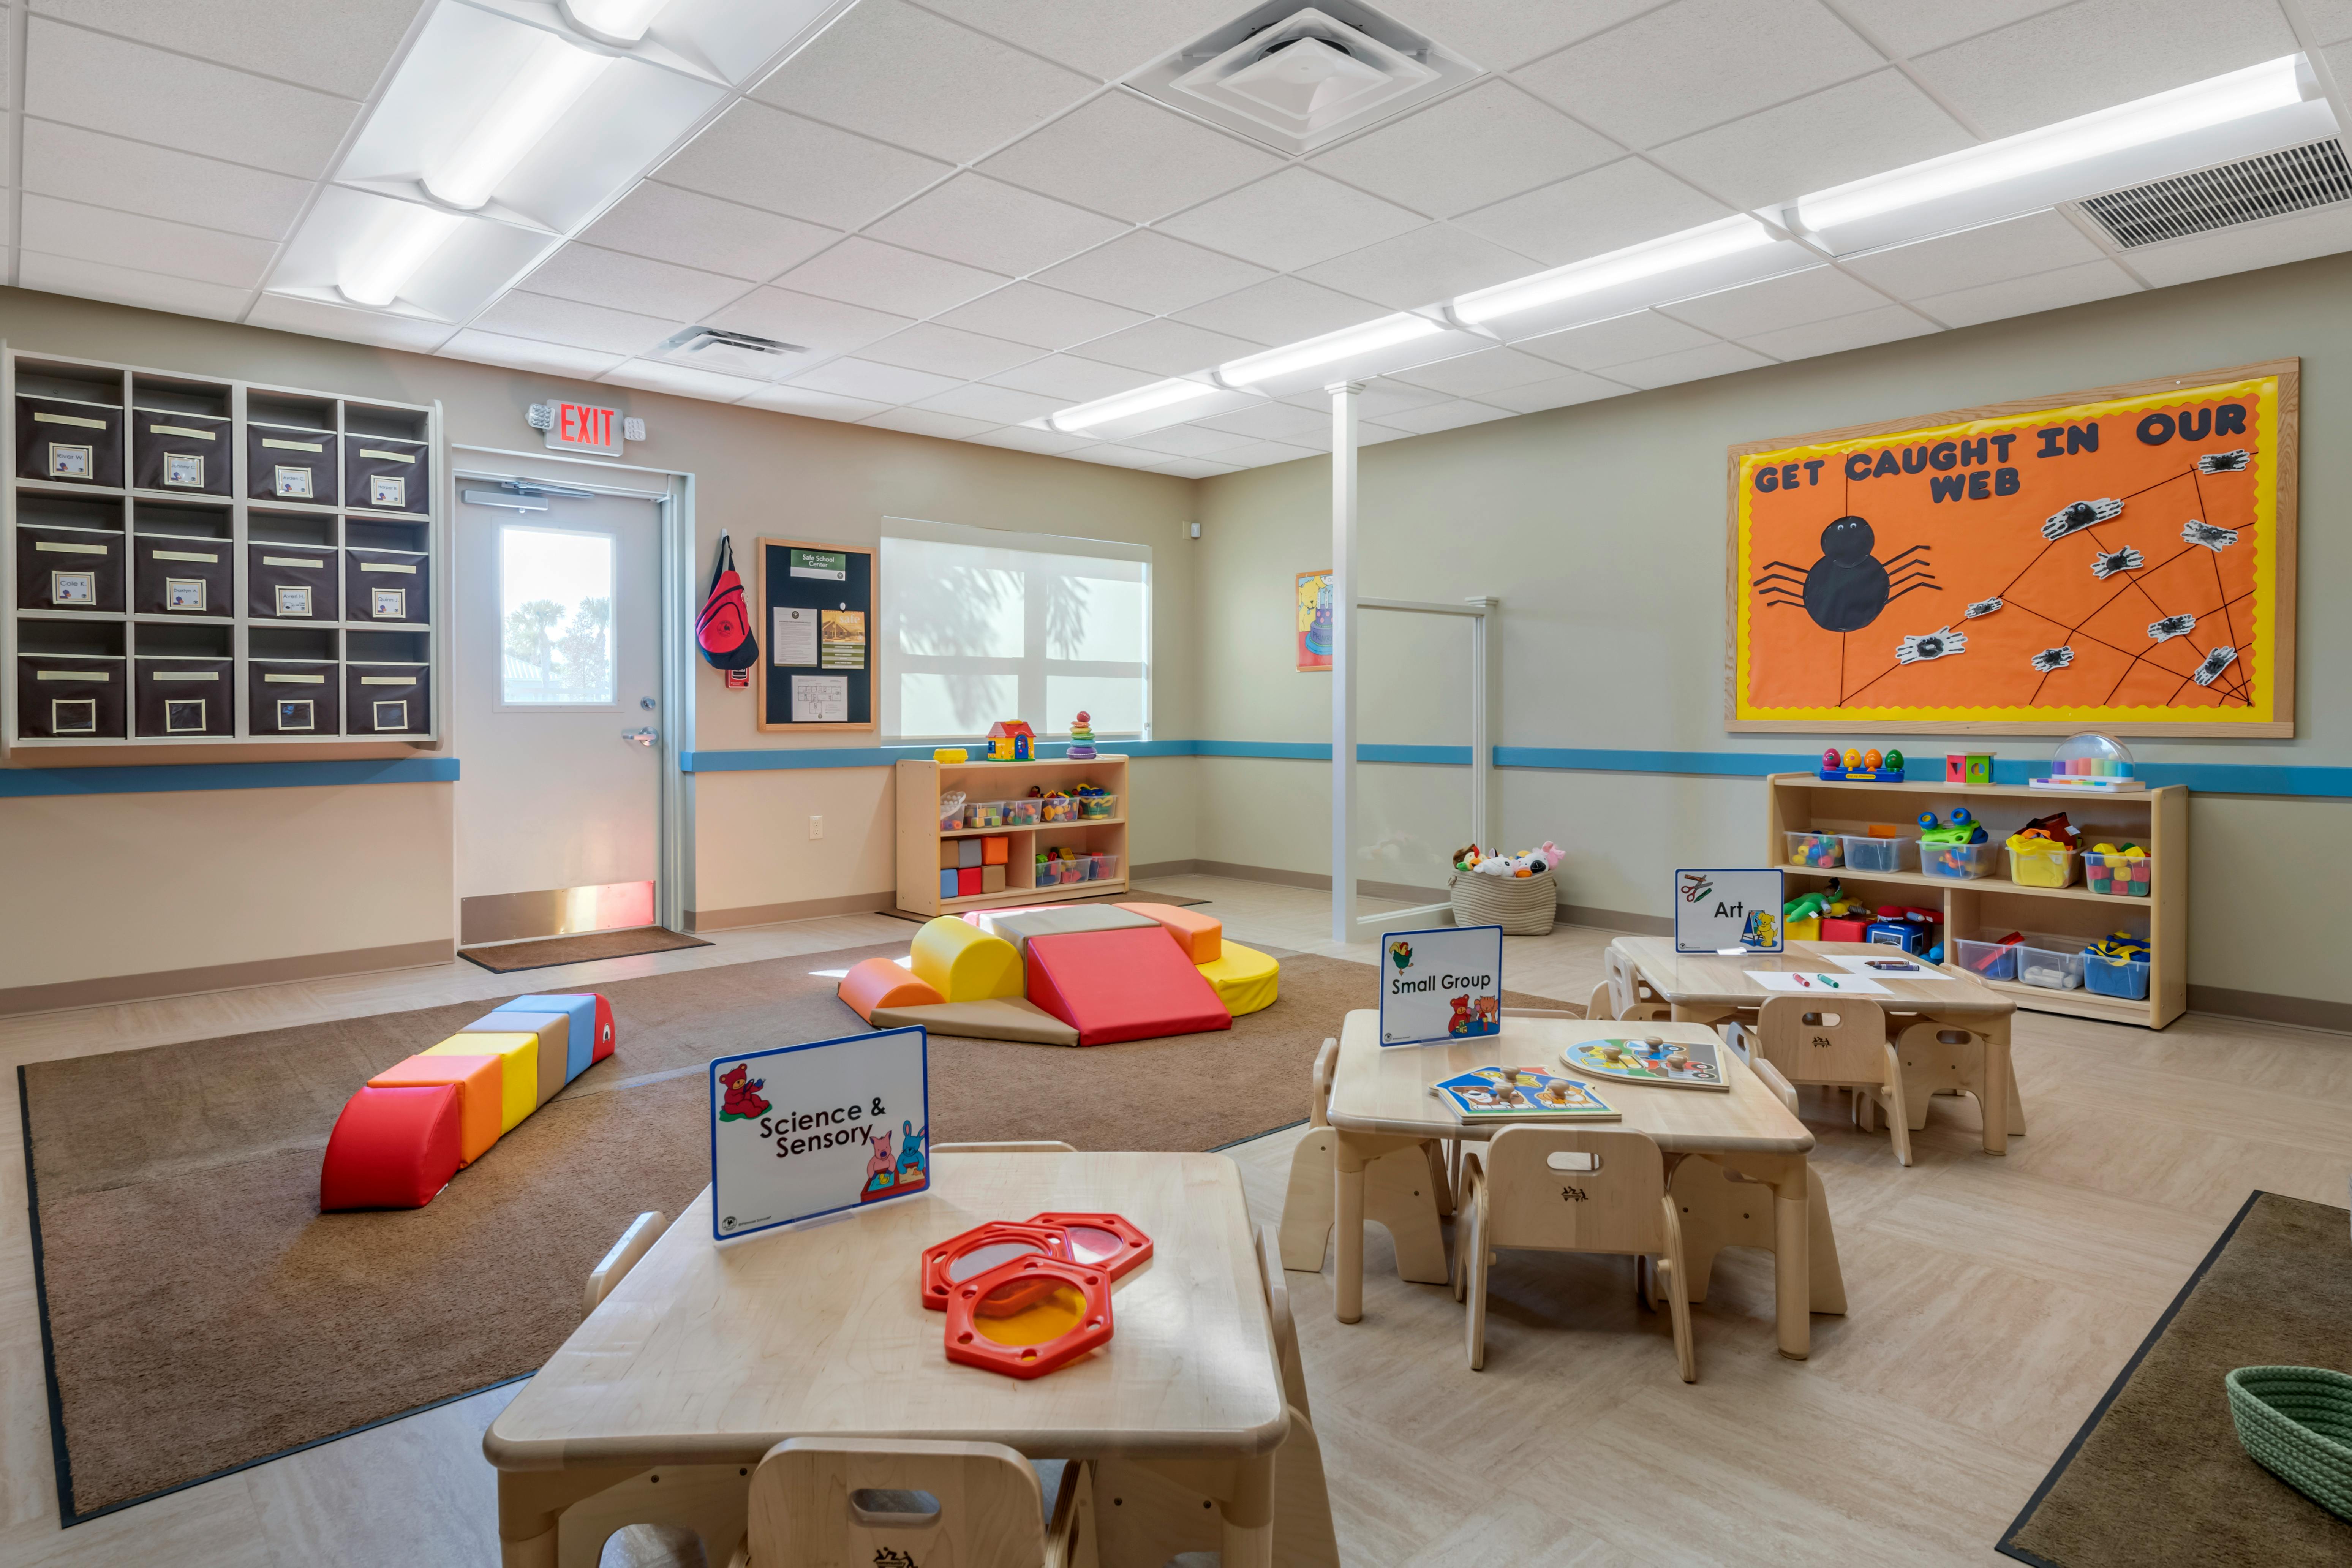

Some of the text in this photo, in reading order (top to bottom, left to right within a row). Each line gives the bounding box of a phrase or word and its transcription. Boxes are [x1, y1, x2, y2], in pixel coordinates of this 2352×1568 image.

[560, 403, 614, 446] EXIT
[1755, 403, 2246, 493] GET CAUGHT IN OUR
[1930, 467, 2020, 504] WEB
[839, 614, 860, 623] safe
[1313, 631, 1332, 642] PRIMR
[1714, 901, 1743, 918] Art
[1392, 974, 1490, 994] Small Group
[760, 1097, 886, 1138] Science &
[776, 1124, 873, 1158] Sensory
